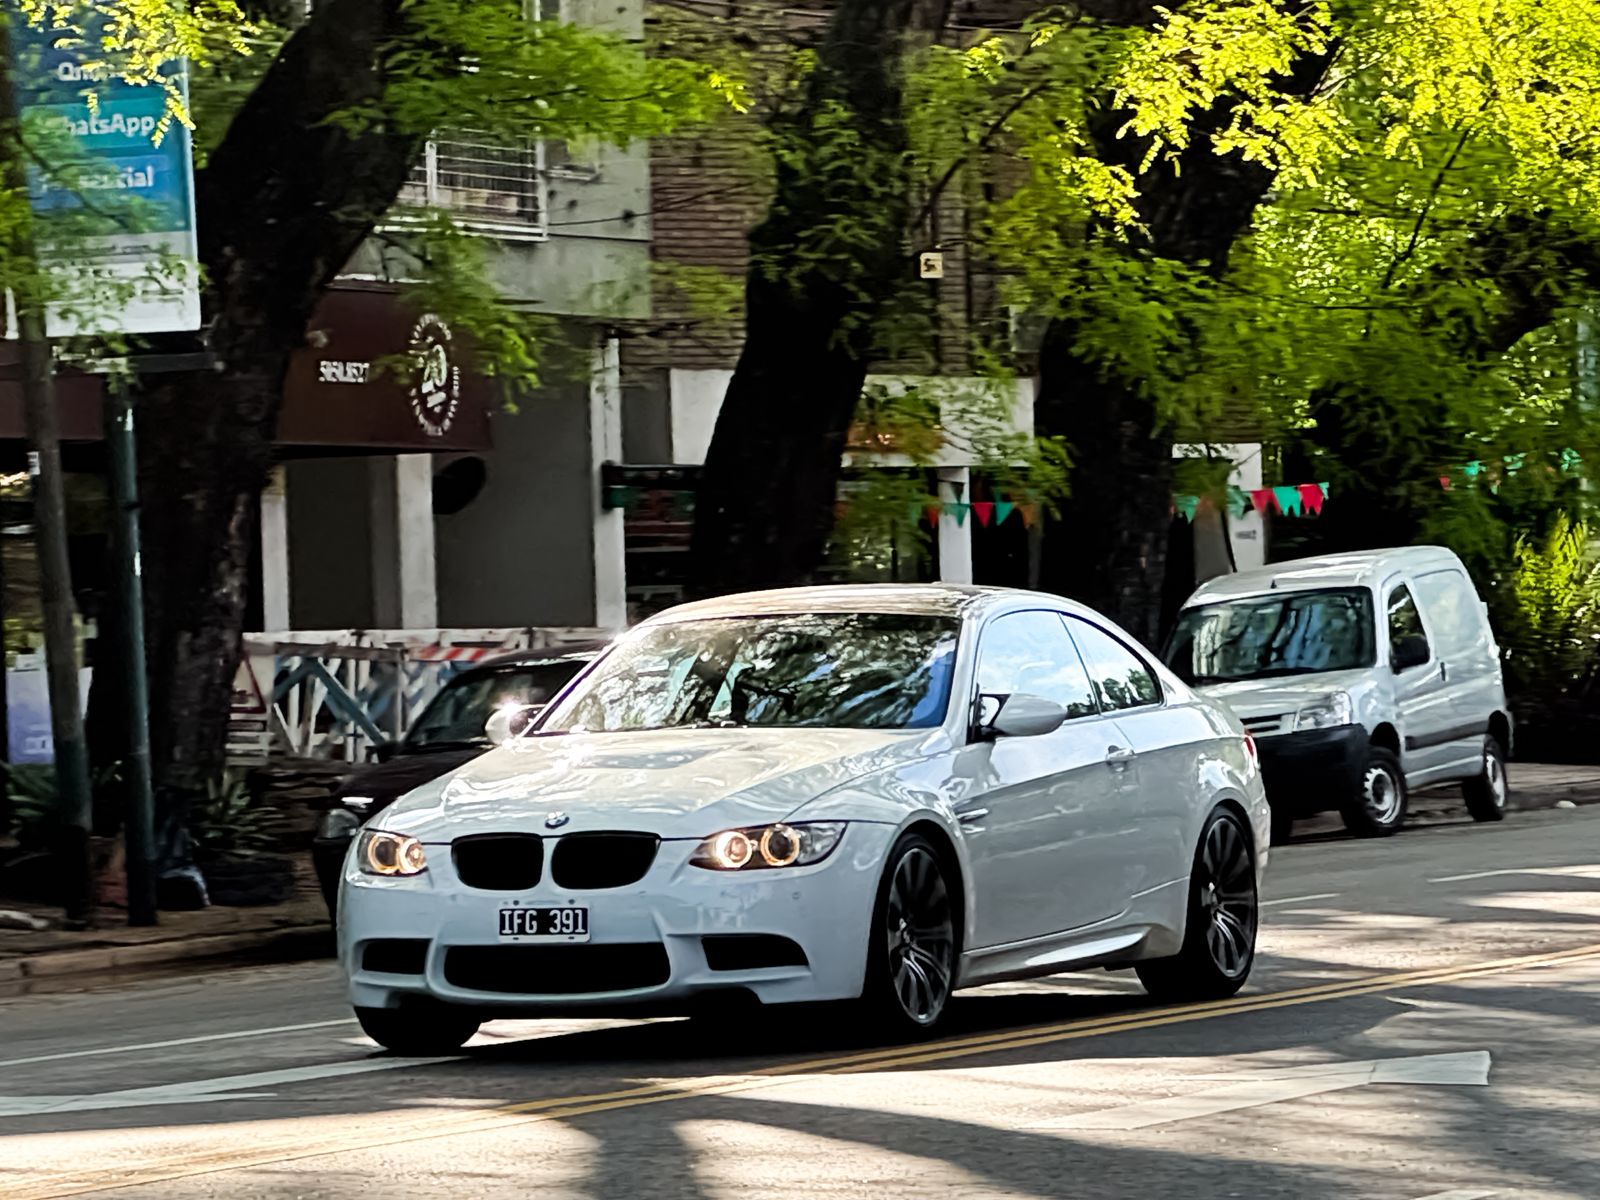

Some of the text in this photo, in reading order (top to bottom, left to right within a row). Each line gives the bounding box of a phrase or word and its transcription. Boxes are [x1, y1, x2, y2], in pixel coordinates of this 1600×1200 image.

[62, 113, 156, 137] hatsApp
[501, 909, 586, 934] IFG 391
